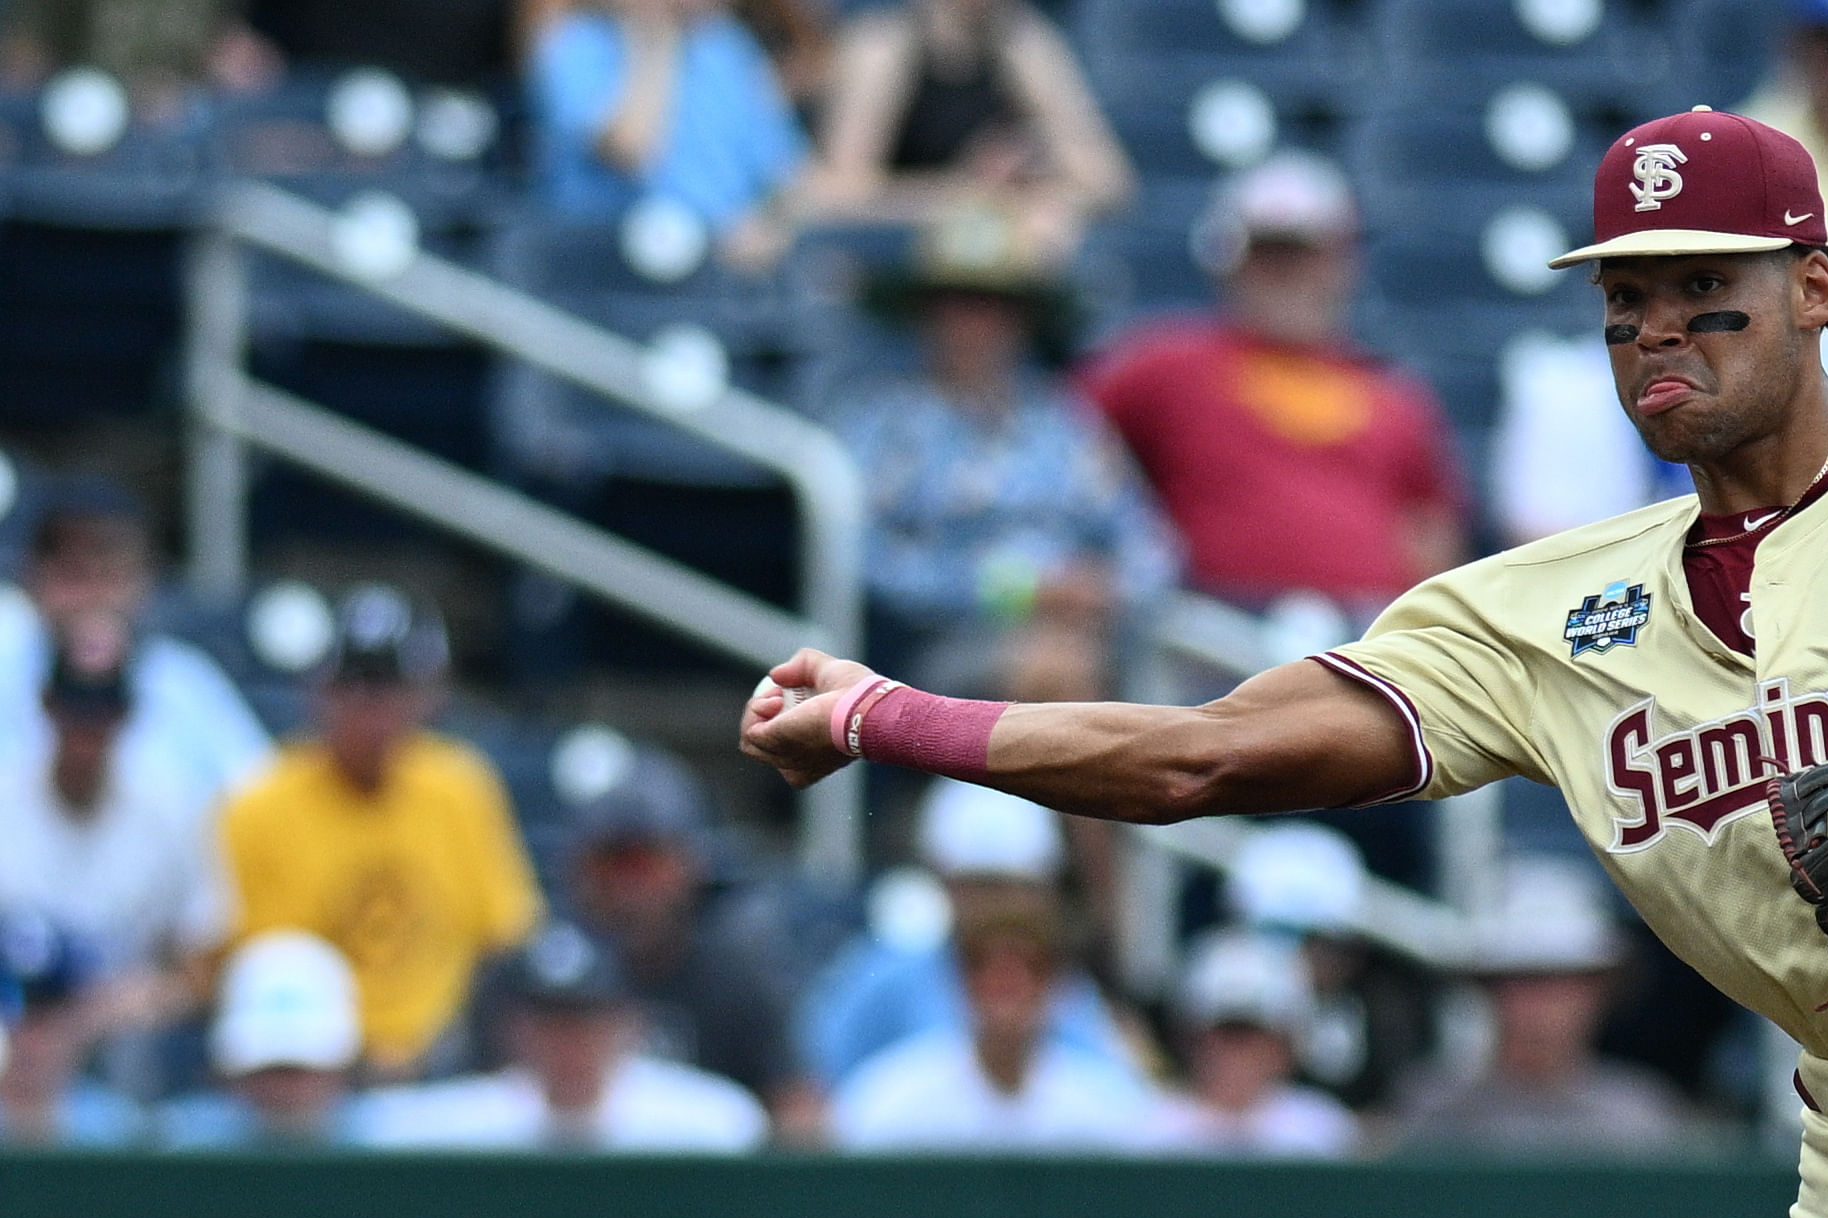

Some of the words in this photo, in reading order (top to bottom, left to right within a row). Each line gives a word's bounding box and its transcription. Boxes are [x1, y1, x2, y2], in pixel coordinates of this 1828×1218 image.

[1565, 621, 1607, 639] WORLD
[1606, 612, 1648, 632] SERIES
[1584, 606, 1634, 626] COLLEGE
